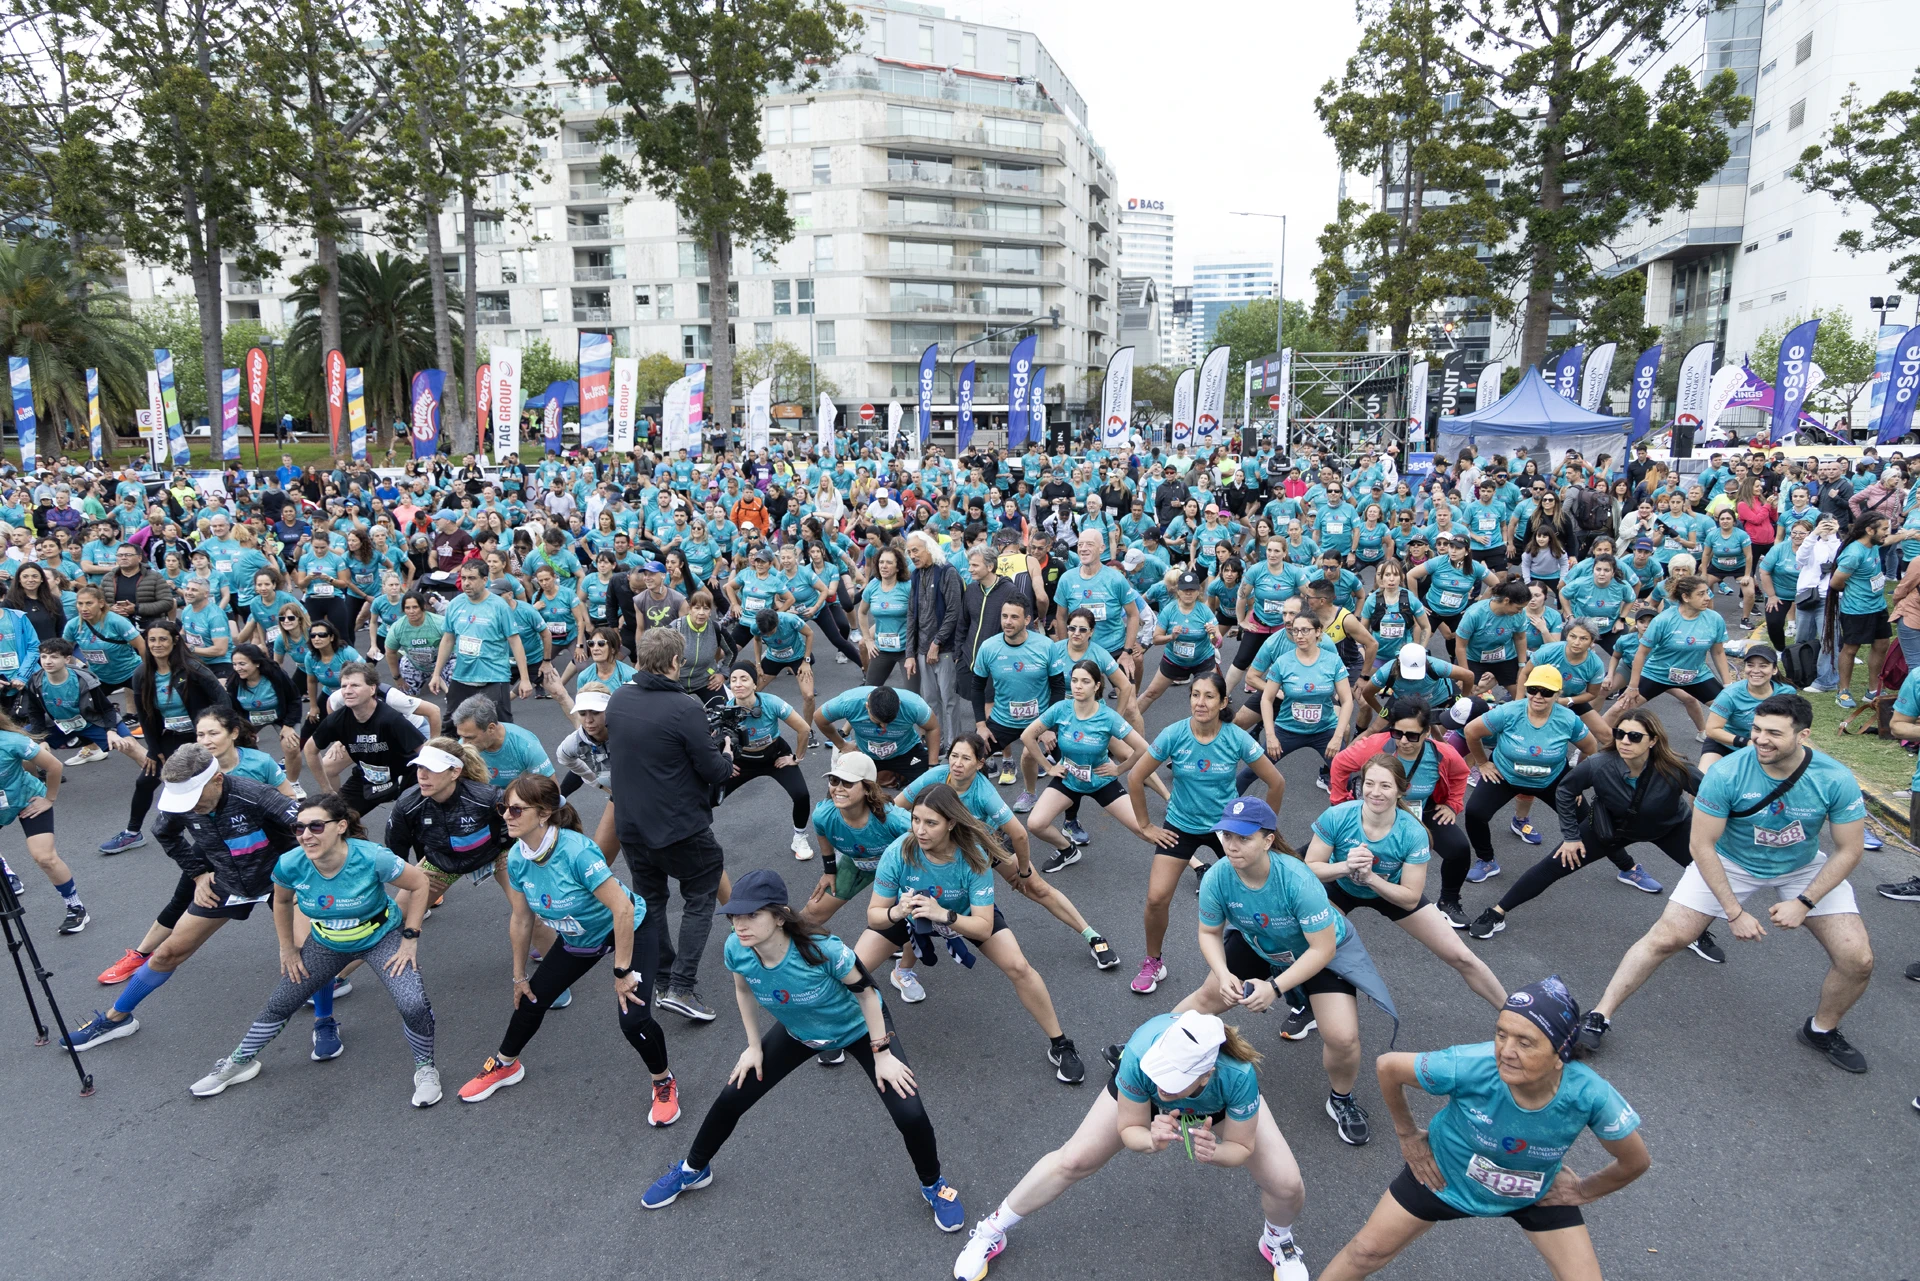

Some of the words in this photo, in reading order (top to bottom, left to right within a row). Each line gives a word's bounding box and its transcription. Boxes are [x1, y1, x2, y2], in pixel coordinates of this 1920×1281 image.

[1140, 199, 1164, 210] BACS
[251, 352, 263, 406] Dexter
[330, 354, 342, 407] Dexter
[479, 368, 491, 412] Dexter
[921, 368, 933, 411] osde
[1559, 365, 1575, 402] sde
[1638, 365, 1653, 410] osde
[1683, 366, 1694, 410] FUNDACIÓN
[1690, 372, 1700, 410] FAVALORO
[1713, 372, 1744, 410] CASASCO
[1783, 346, 1805, 402] osde
[1896, 346, 1920, 402] osde
[499, 379, 512, 422] GROUP
[620, 384, 630, 418] GROUP
[960, 380, 973, 421] osde
[1031, 387, 1042, 421] osde
[499, 425, 511, 449] TAG
[618, 421, 628, 440] TAG
[1484, 651, 1503, 661] 4181
[1012, 705, 1036, 717] 4247
[1293, 708, 1319, 719] 3106
[870, 744, 895, 757] 3552
[1742, 792, 1761, 800] osde
[1757, 829, 1802, 844] 4268
[1310, 908, 1329, 923] RUS
[1469, 1108, 1493, 1126] osde
[1475, 1133, 1498, 1149] VERDE
[1528, 1144, 1570, 1154] FUNDACIÓN
[1474, 1166, 1533, 1191] 3135
